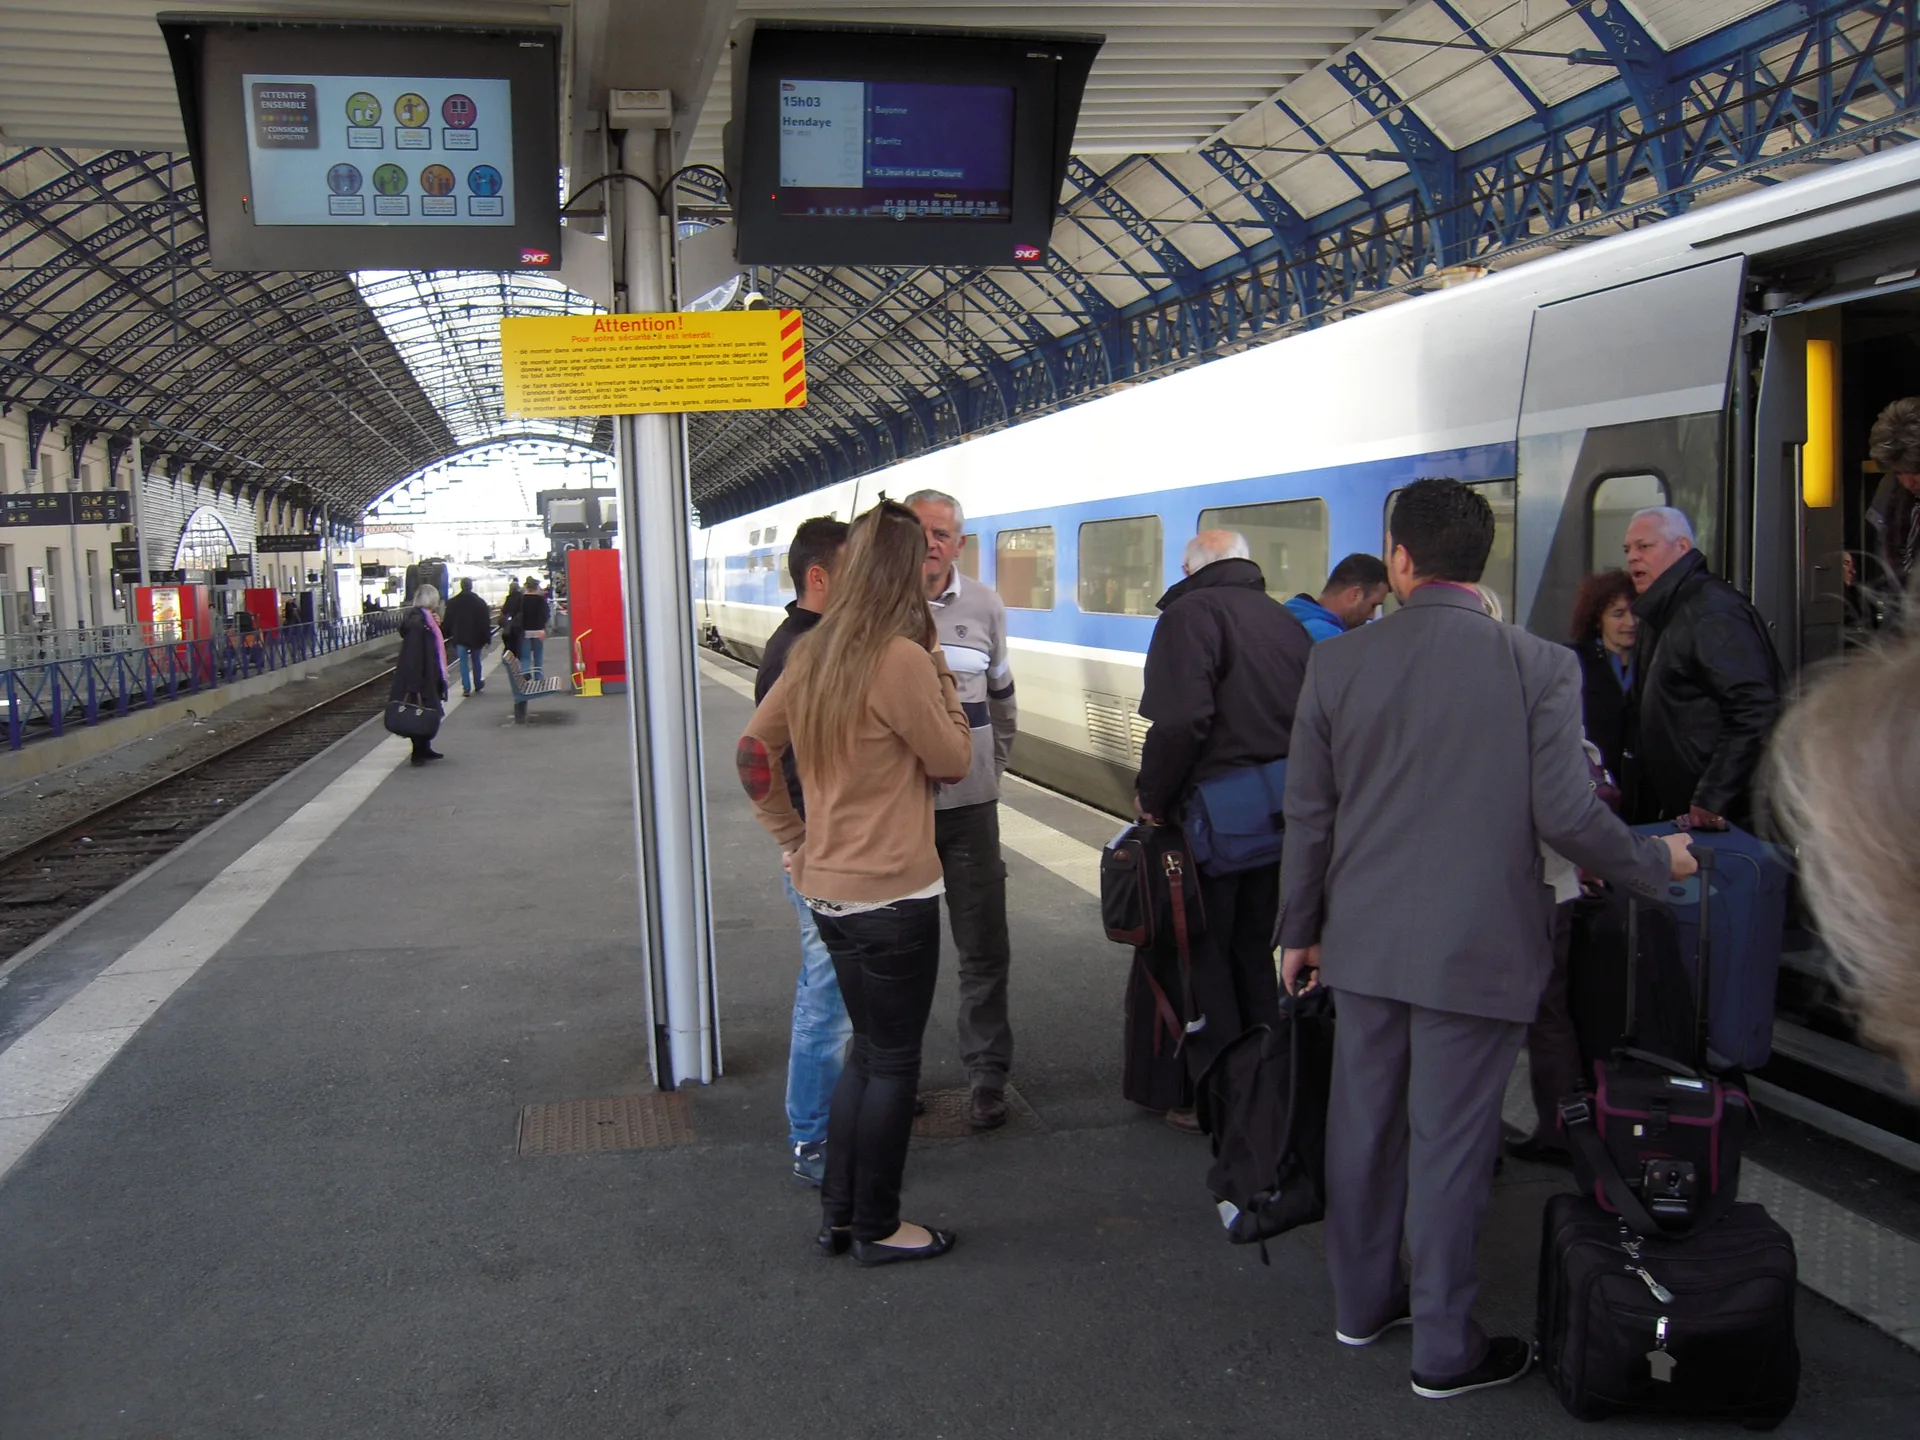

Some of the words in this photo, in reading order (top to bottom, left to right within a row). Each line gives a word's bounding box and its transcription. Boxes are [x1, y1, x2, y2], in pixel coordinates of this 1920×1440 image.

[260, 91, 307, 99] ATTENTIFS
[261, 101, 307, 109] ENSEMBLE
[783, 96, 821, 107] 15h03
[782, 117, 832, 128] Hendaye
[521, 254, 550, 262] SNCF
[1014, 250, 1040, 258] SNCF
